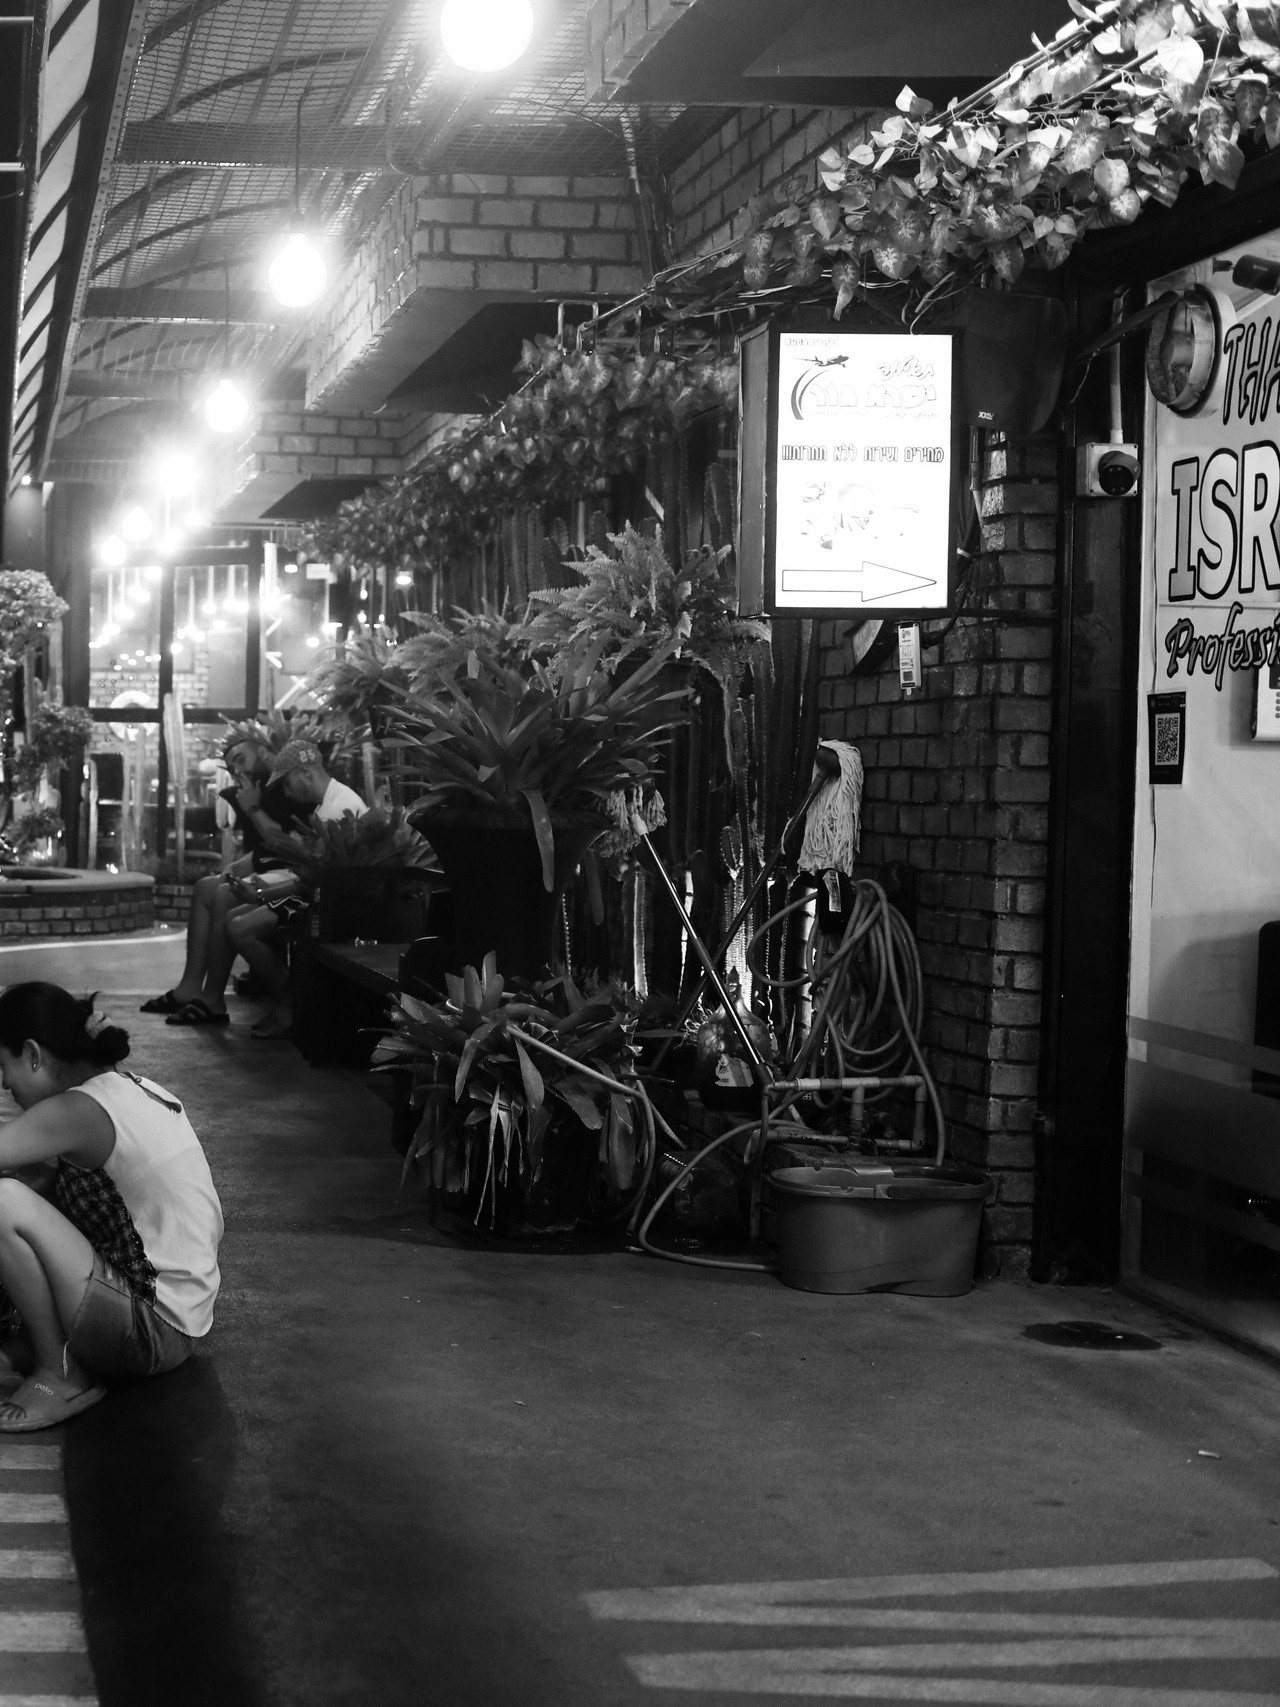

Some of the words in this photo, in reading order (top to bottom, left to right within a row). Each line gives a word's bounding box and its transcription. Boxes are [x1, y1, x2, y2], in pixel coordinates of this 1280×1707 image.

[833, 443, 858, 462] ללא
[863, 446, 899, 463] ושירות
[904, 446, 945, 463] מחירים
[1168, 439, 1280, 602] ISR
